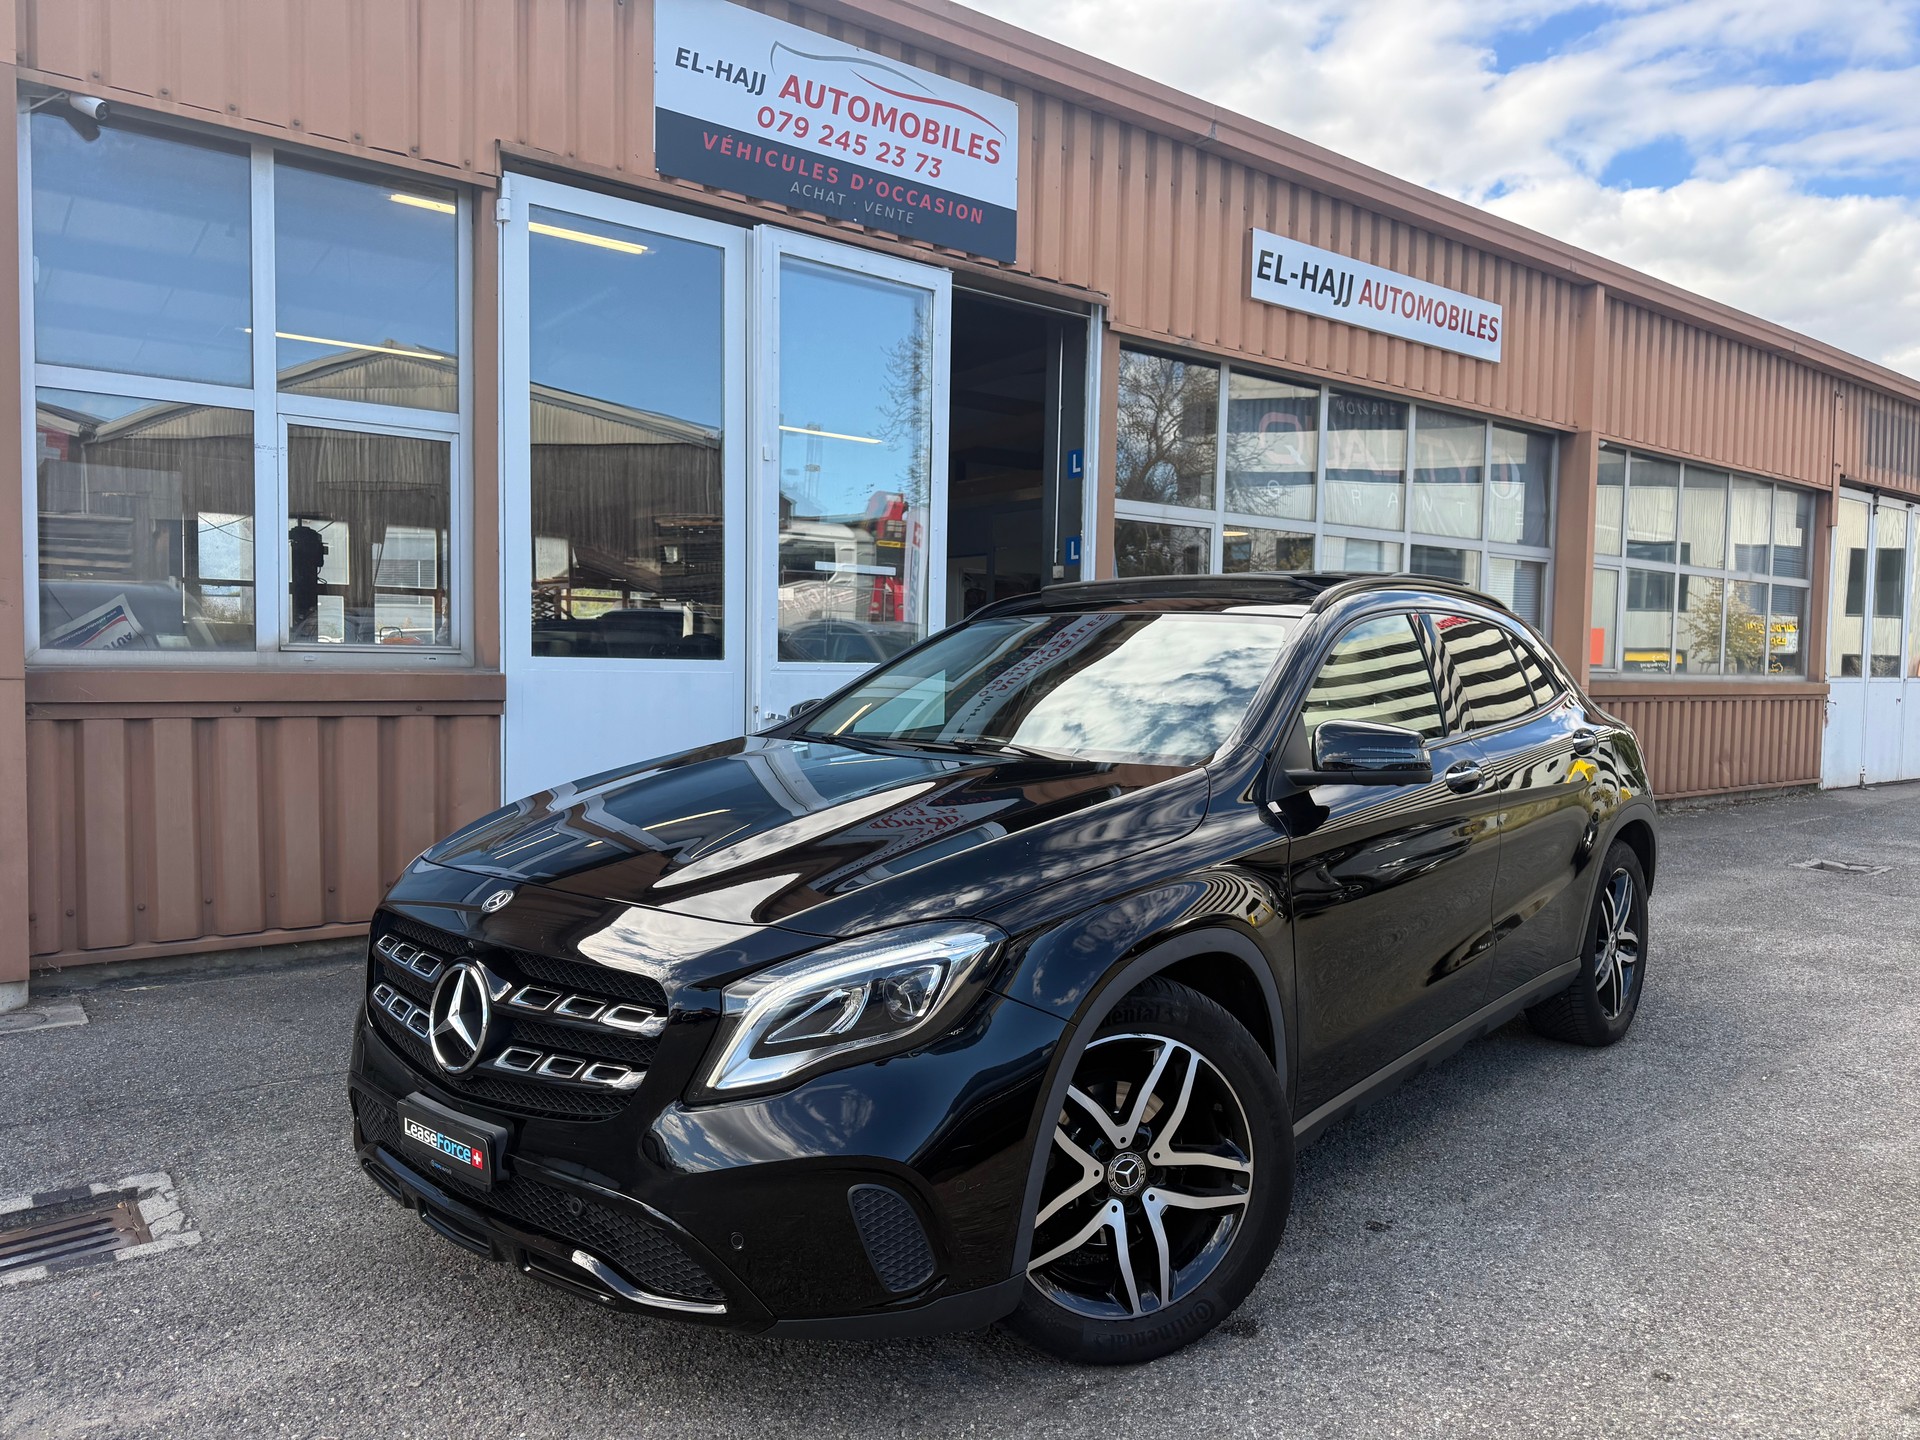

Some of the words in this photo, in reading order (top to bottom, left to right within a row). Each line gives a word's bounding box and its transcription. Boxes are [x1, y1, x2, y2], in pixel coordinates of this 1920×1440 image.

[674, 47, 767, 96] EL-HAJJ
[778, 74, 1001, 165] AUTOMOBILES
[757, 105, 810, 138] 079
[818, 123, 867, 156] 245
[876, 140, 906, 168] 23
[914, 152, 943, 178] 73
[702, 131, 839, 184] VÉHICULES
[851, 173, 983, 224] D'OCCASION
[790, 181, 847, 205] ACHAT
[864, 201, 915, 224] VENTE
[1256, 249, 1354, 308] EL-HAJJ
[1358, 279, 1499, 343] AUTOMOBILES
[1072, 454, 1081, 473] L
[1070, 541, 1079, 560] L
[404, 1117, 471, 1161] LeaseForce
